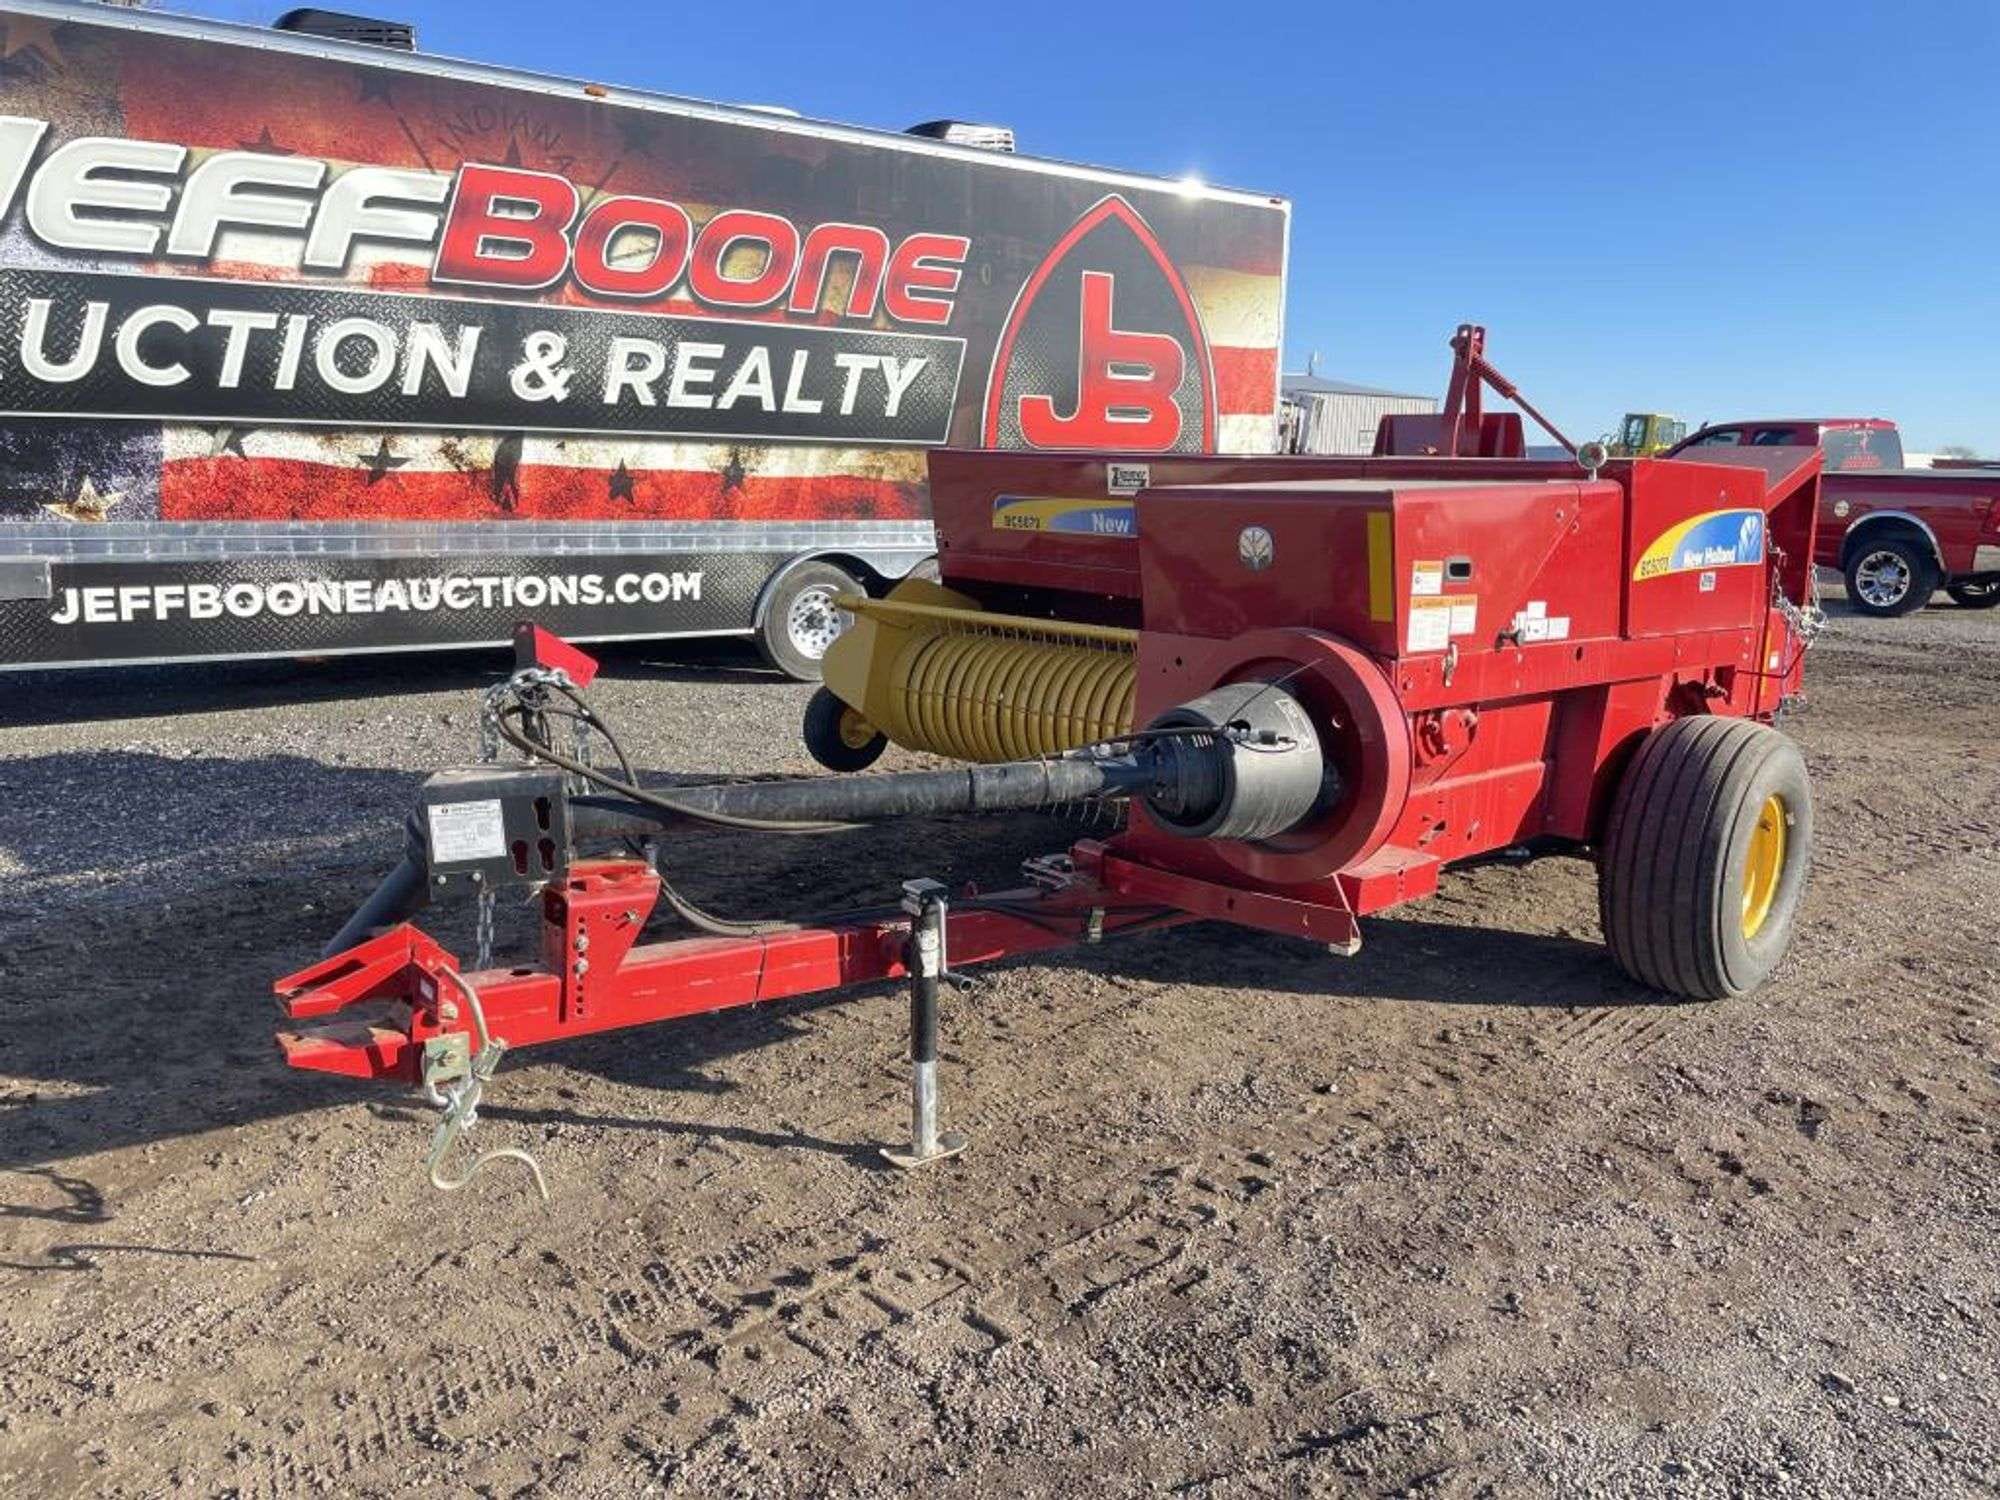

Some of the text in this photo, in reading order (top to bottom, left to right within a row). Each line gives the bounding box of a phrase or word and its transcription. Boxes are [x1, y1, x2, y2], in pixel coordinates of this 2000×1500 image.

[0, 299, 928, 418] UCTION & REALTY
[1092, 510, 1129, 534] New
[50, 572, 703, 625] JEFFBOONEAUCTIONS.COM
